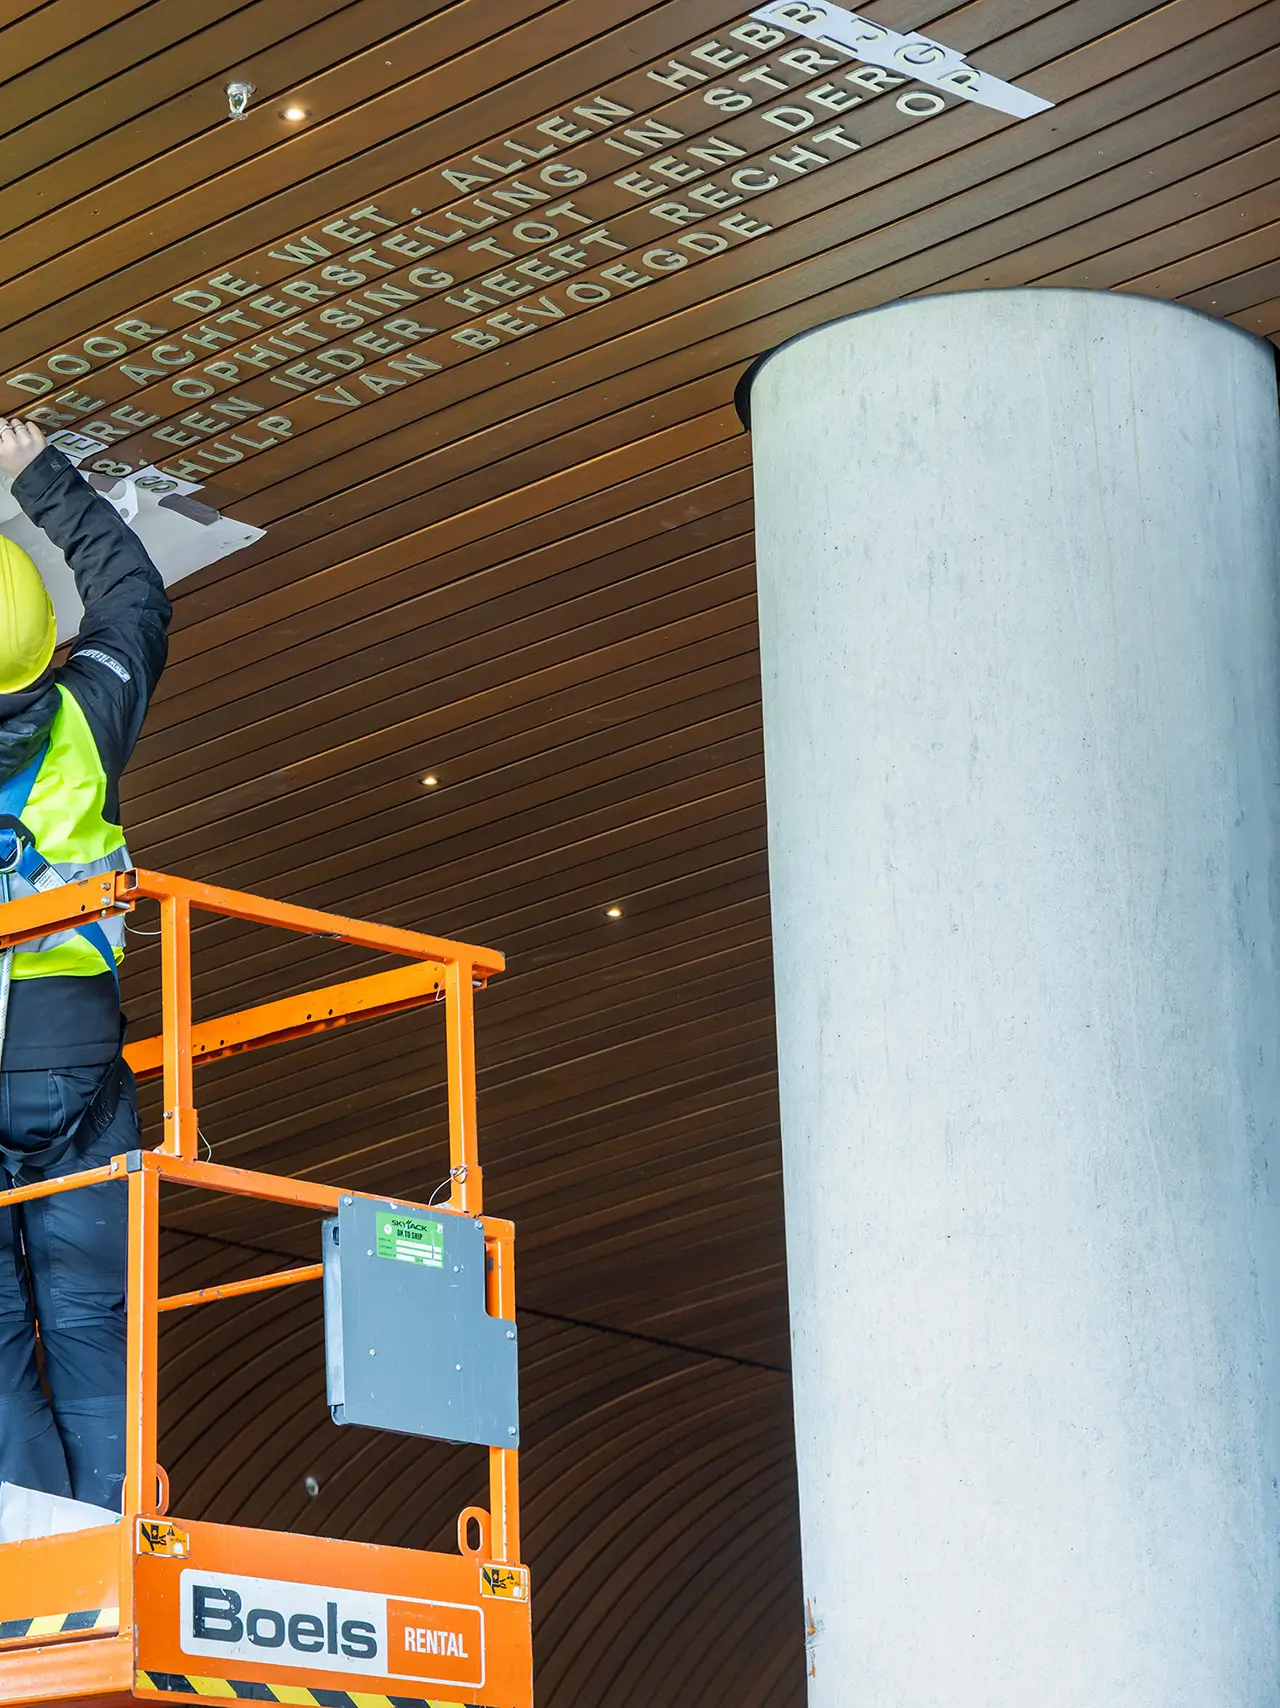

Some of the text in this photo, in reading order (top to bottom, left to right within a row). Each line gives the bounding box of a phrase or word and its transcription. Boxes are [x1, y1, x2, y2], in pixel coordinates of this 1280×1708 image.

[6, 319, 167, 395] DOOR
[172, 272, 262, 314] DE
[268, 204, 423, 266] WET.
[441, 96, 634, 194] ALLEN
[646, 2, 827, 90] HEBB
[119, 163, 588, 385] ACHTERSTELLING
[604, 118, 684, 157] IN
[152, 395, 266, 446] EEN
[269, 318, 438, 392] IEDER
[444, 229, 627, 313] HEEFT
[649, 124, 862, 225] RECHT
[895, 68, 981, 116] OP
[171, 267, 454, 399] OPHITSING
[468, 200, 594, 259] TOT
[613, 136, 747, 198] EEN
[760, 43, 945, 133] DERG
[135, 212, 773, 494] SHULP VAN BEVOEGDE
[392, 1219, 427, 1232] SKYJACK
[405, 1230, 410, 1238] TO
[411, 1232, 423, 1240] SHIP
[192, 1584, 378, 1660] Boels
[404, 1626, 469, 1659] RENTAL
